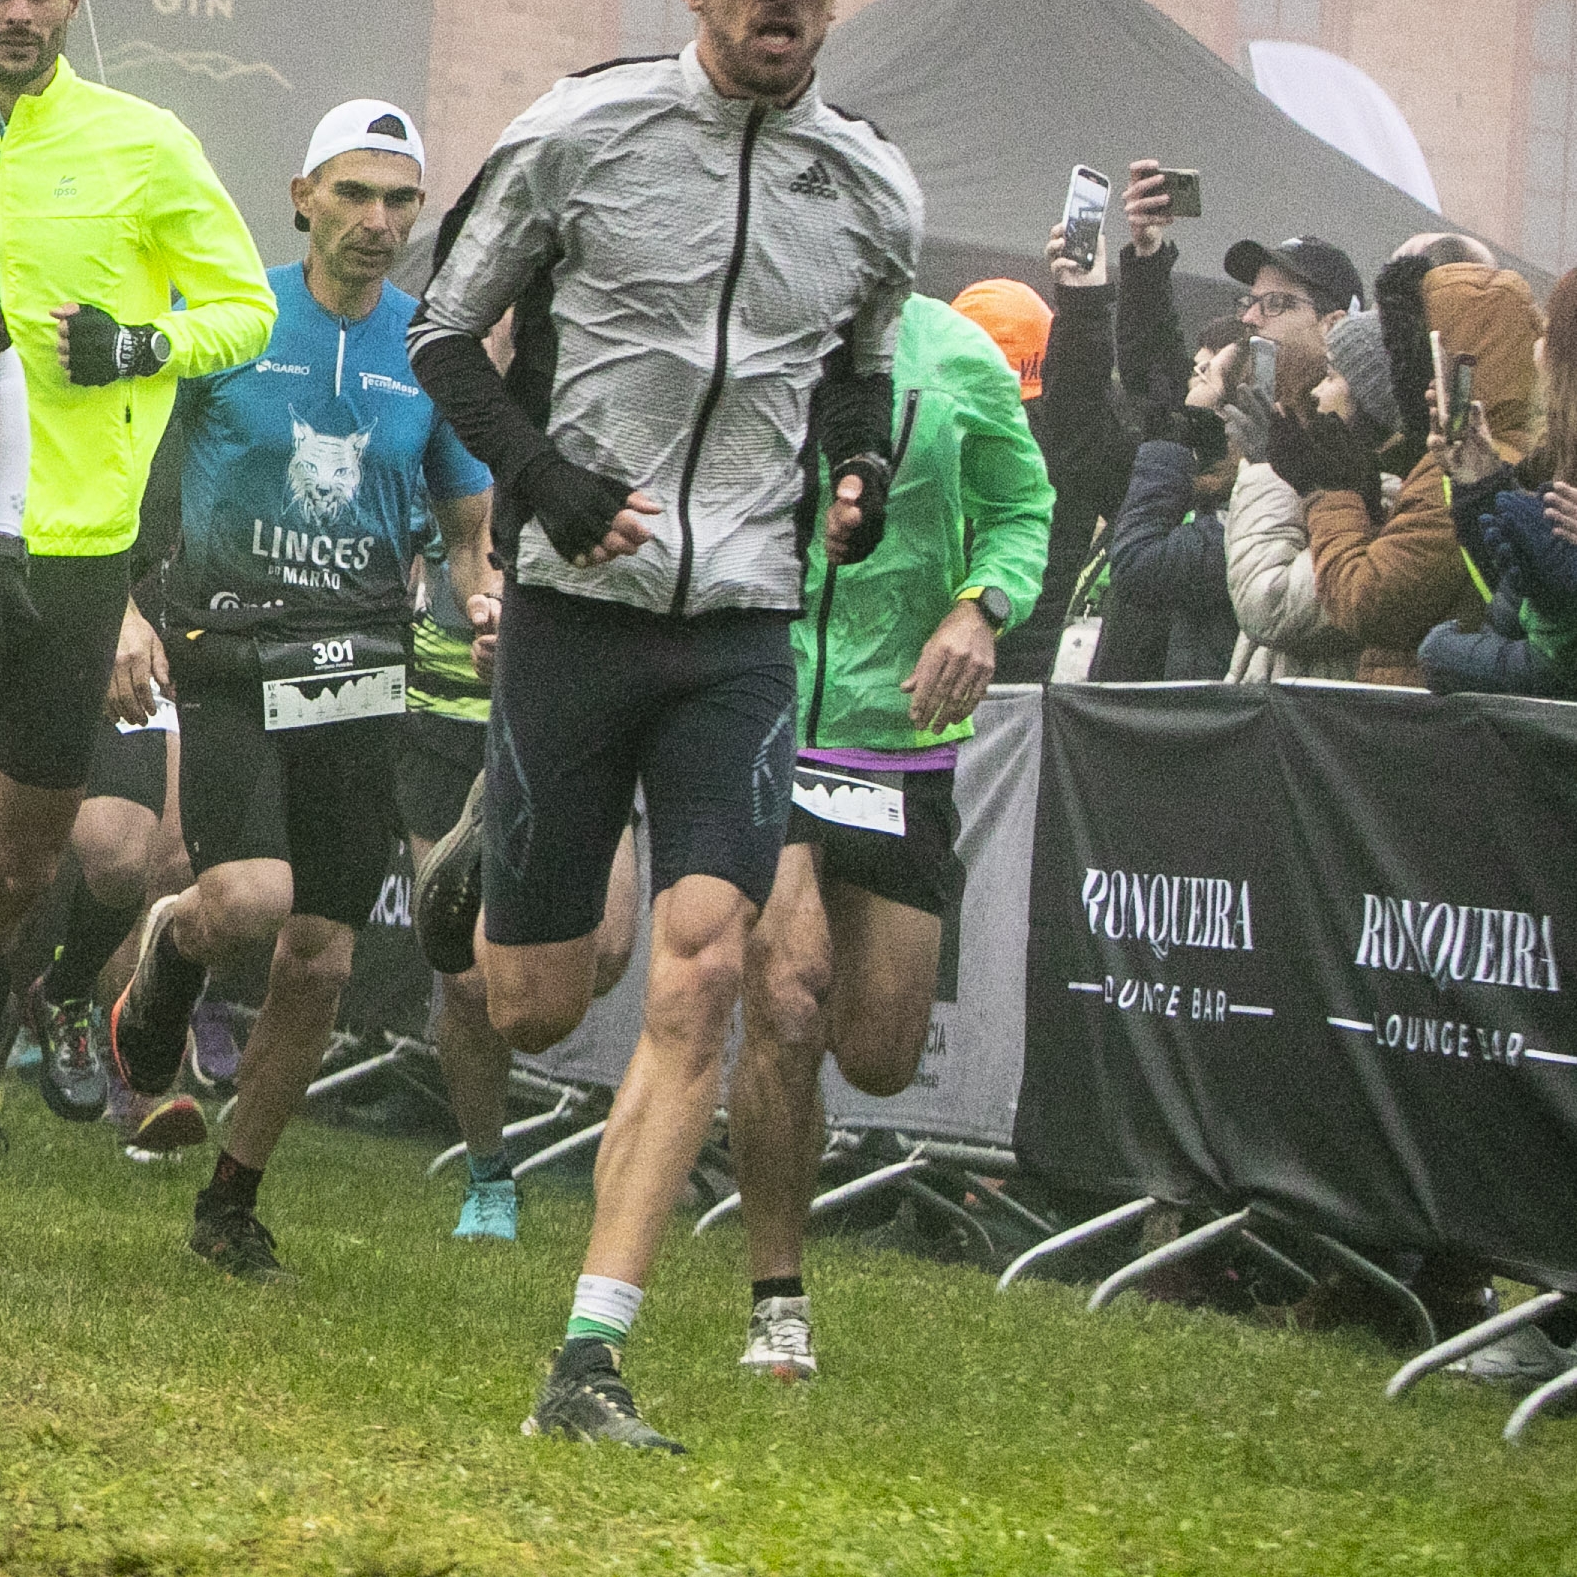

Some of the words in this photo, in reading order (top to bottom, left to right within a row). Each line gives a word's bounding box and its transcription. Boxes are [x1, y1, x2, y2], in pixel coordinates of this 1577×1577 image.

[251, 518, 375, 571] LINCES
[283, 564, 342, 591] MARÃO
[312, 639, 354, 665] 301
[1081, 866, 1255, 961] RONQUEIRA
[1355, 893, 1560, 991] RONQUEIRA
[1191, 987, 1226, 1023] BAR
